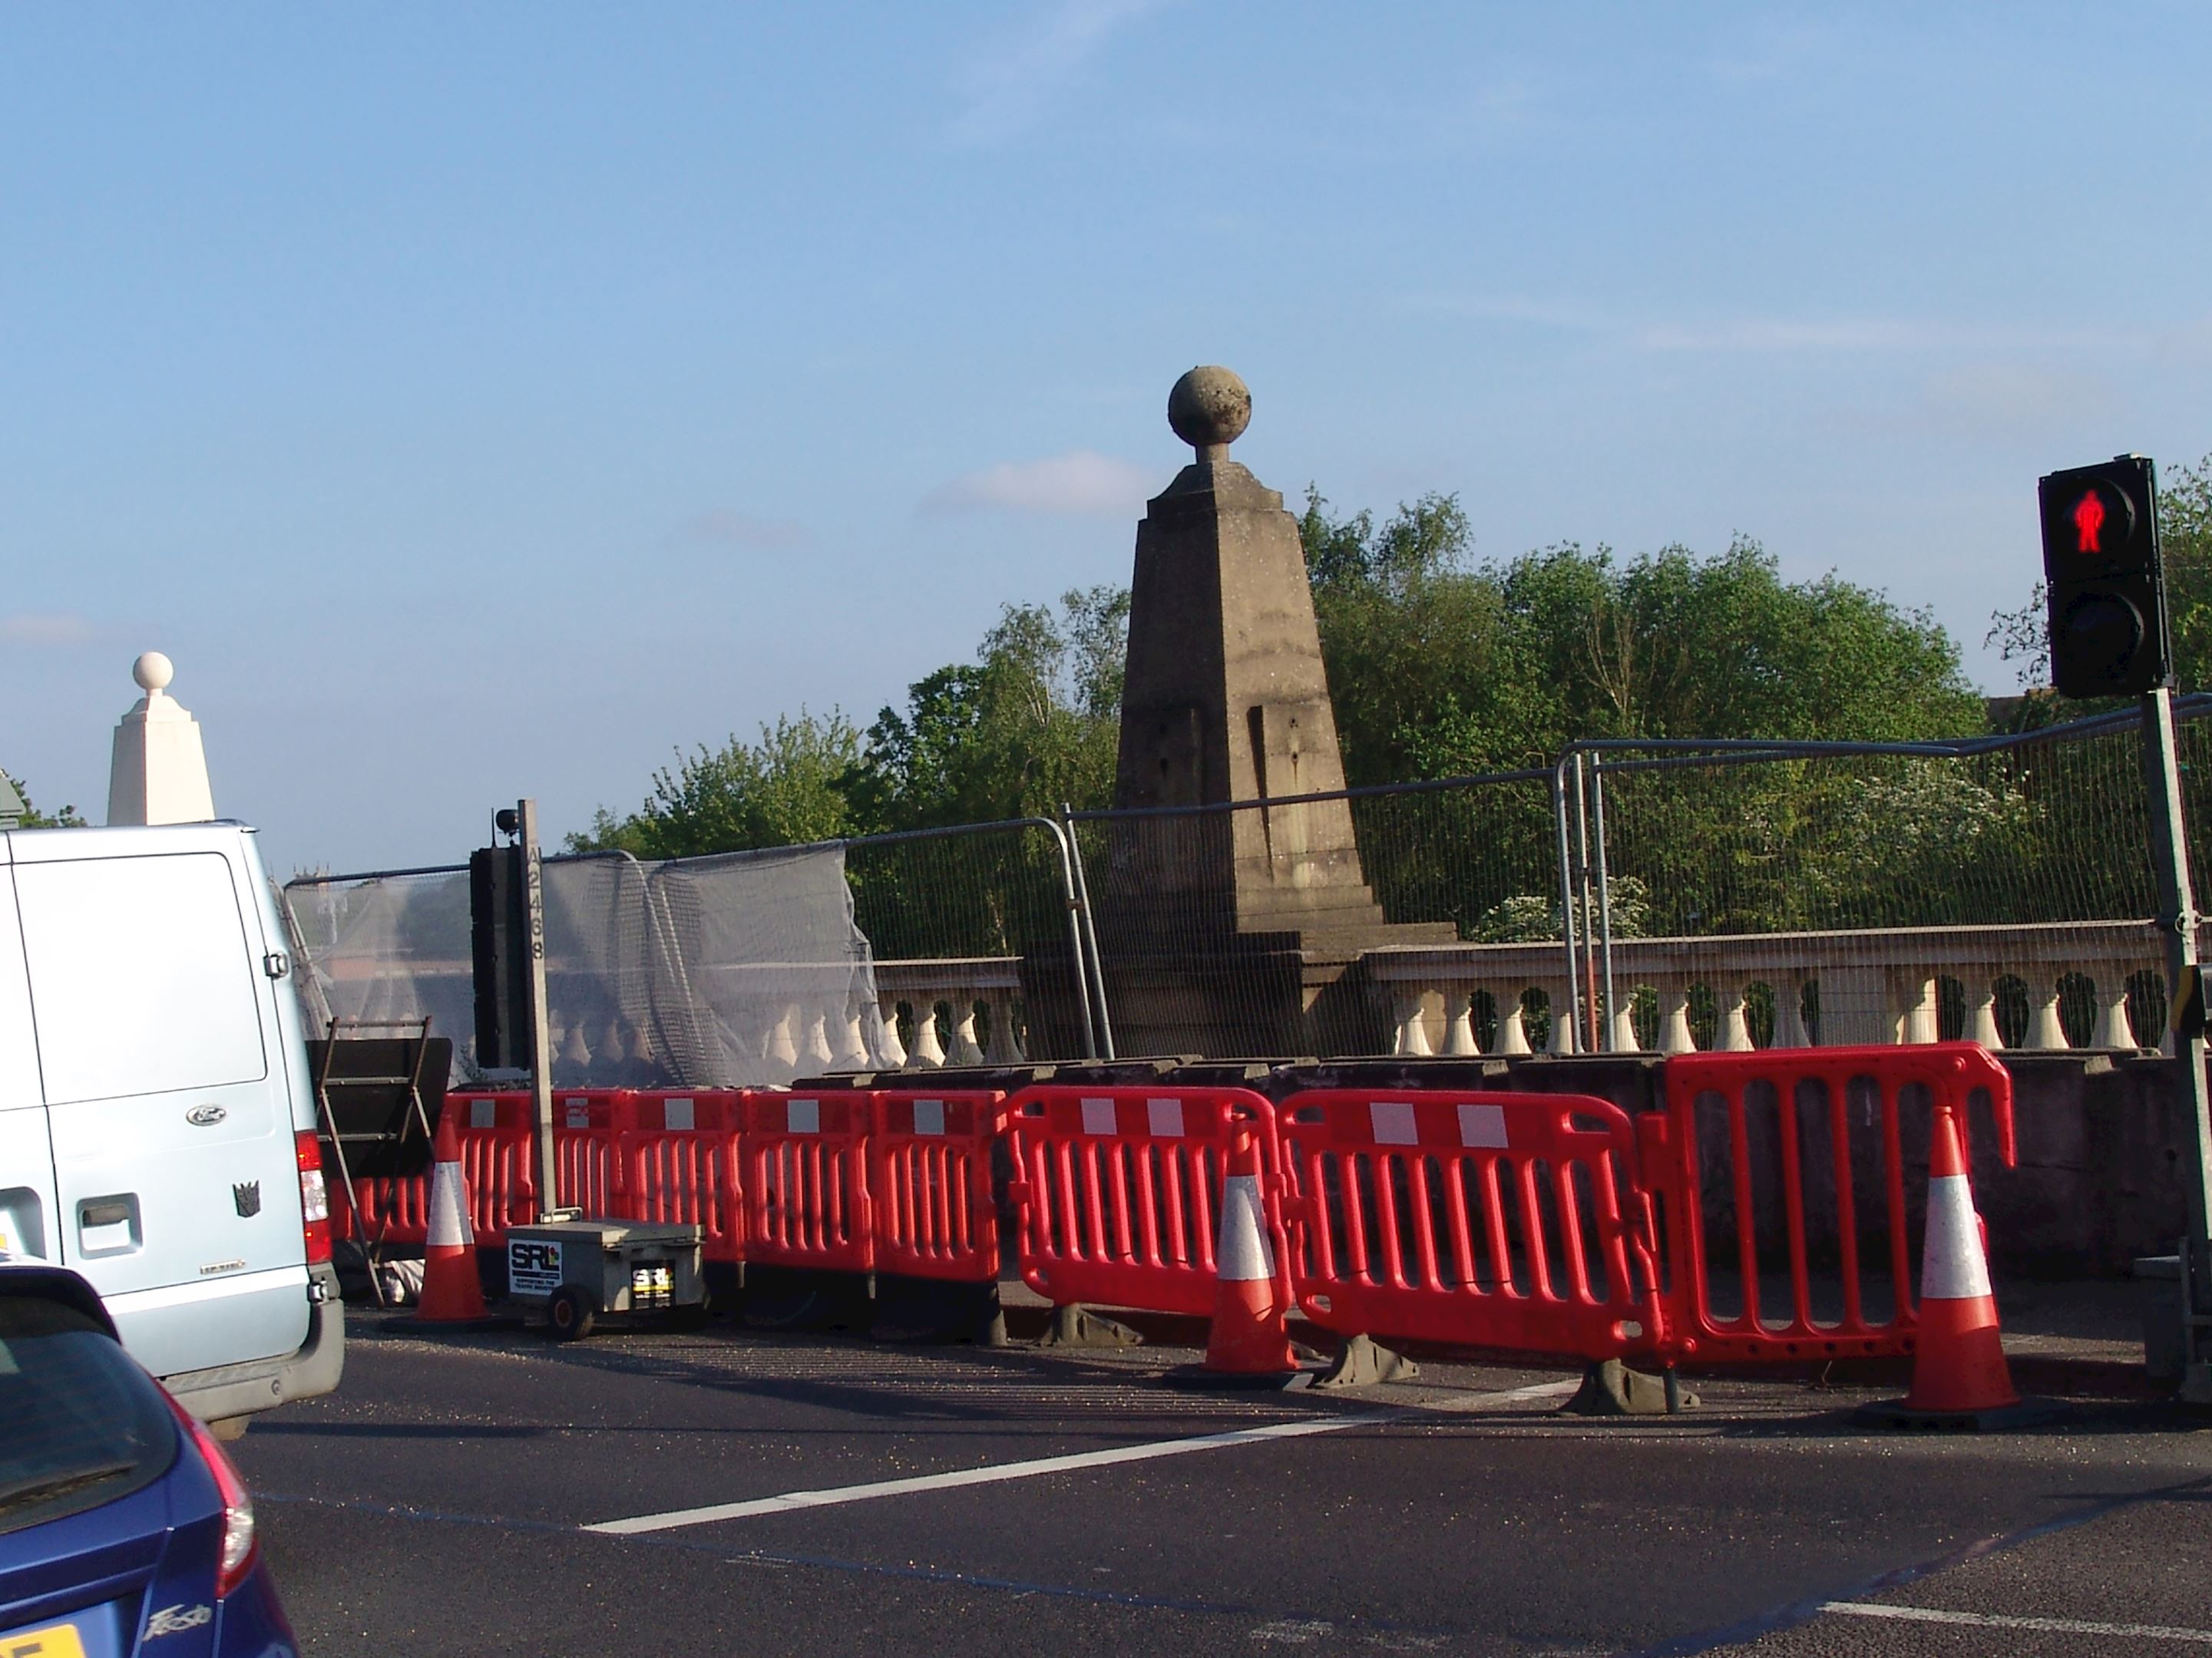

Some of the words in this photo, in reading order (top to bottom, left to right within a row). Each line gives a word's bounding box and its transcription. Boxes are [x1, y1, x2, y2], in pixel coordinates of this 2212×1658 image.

[528, 847, 543, 959] A2468
[511, 1243, 560, 1271] SRL
[632, 1268, 673, 1286] SRL
